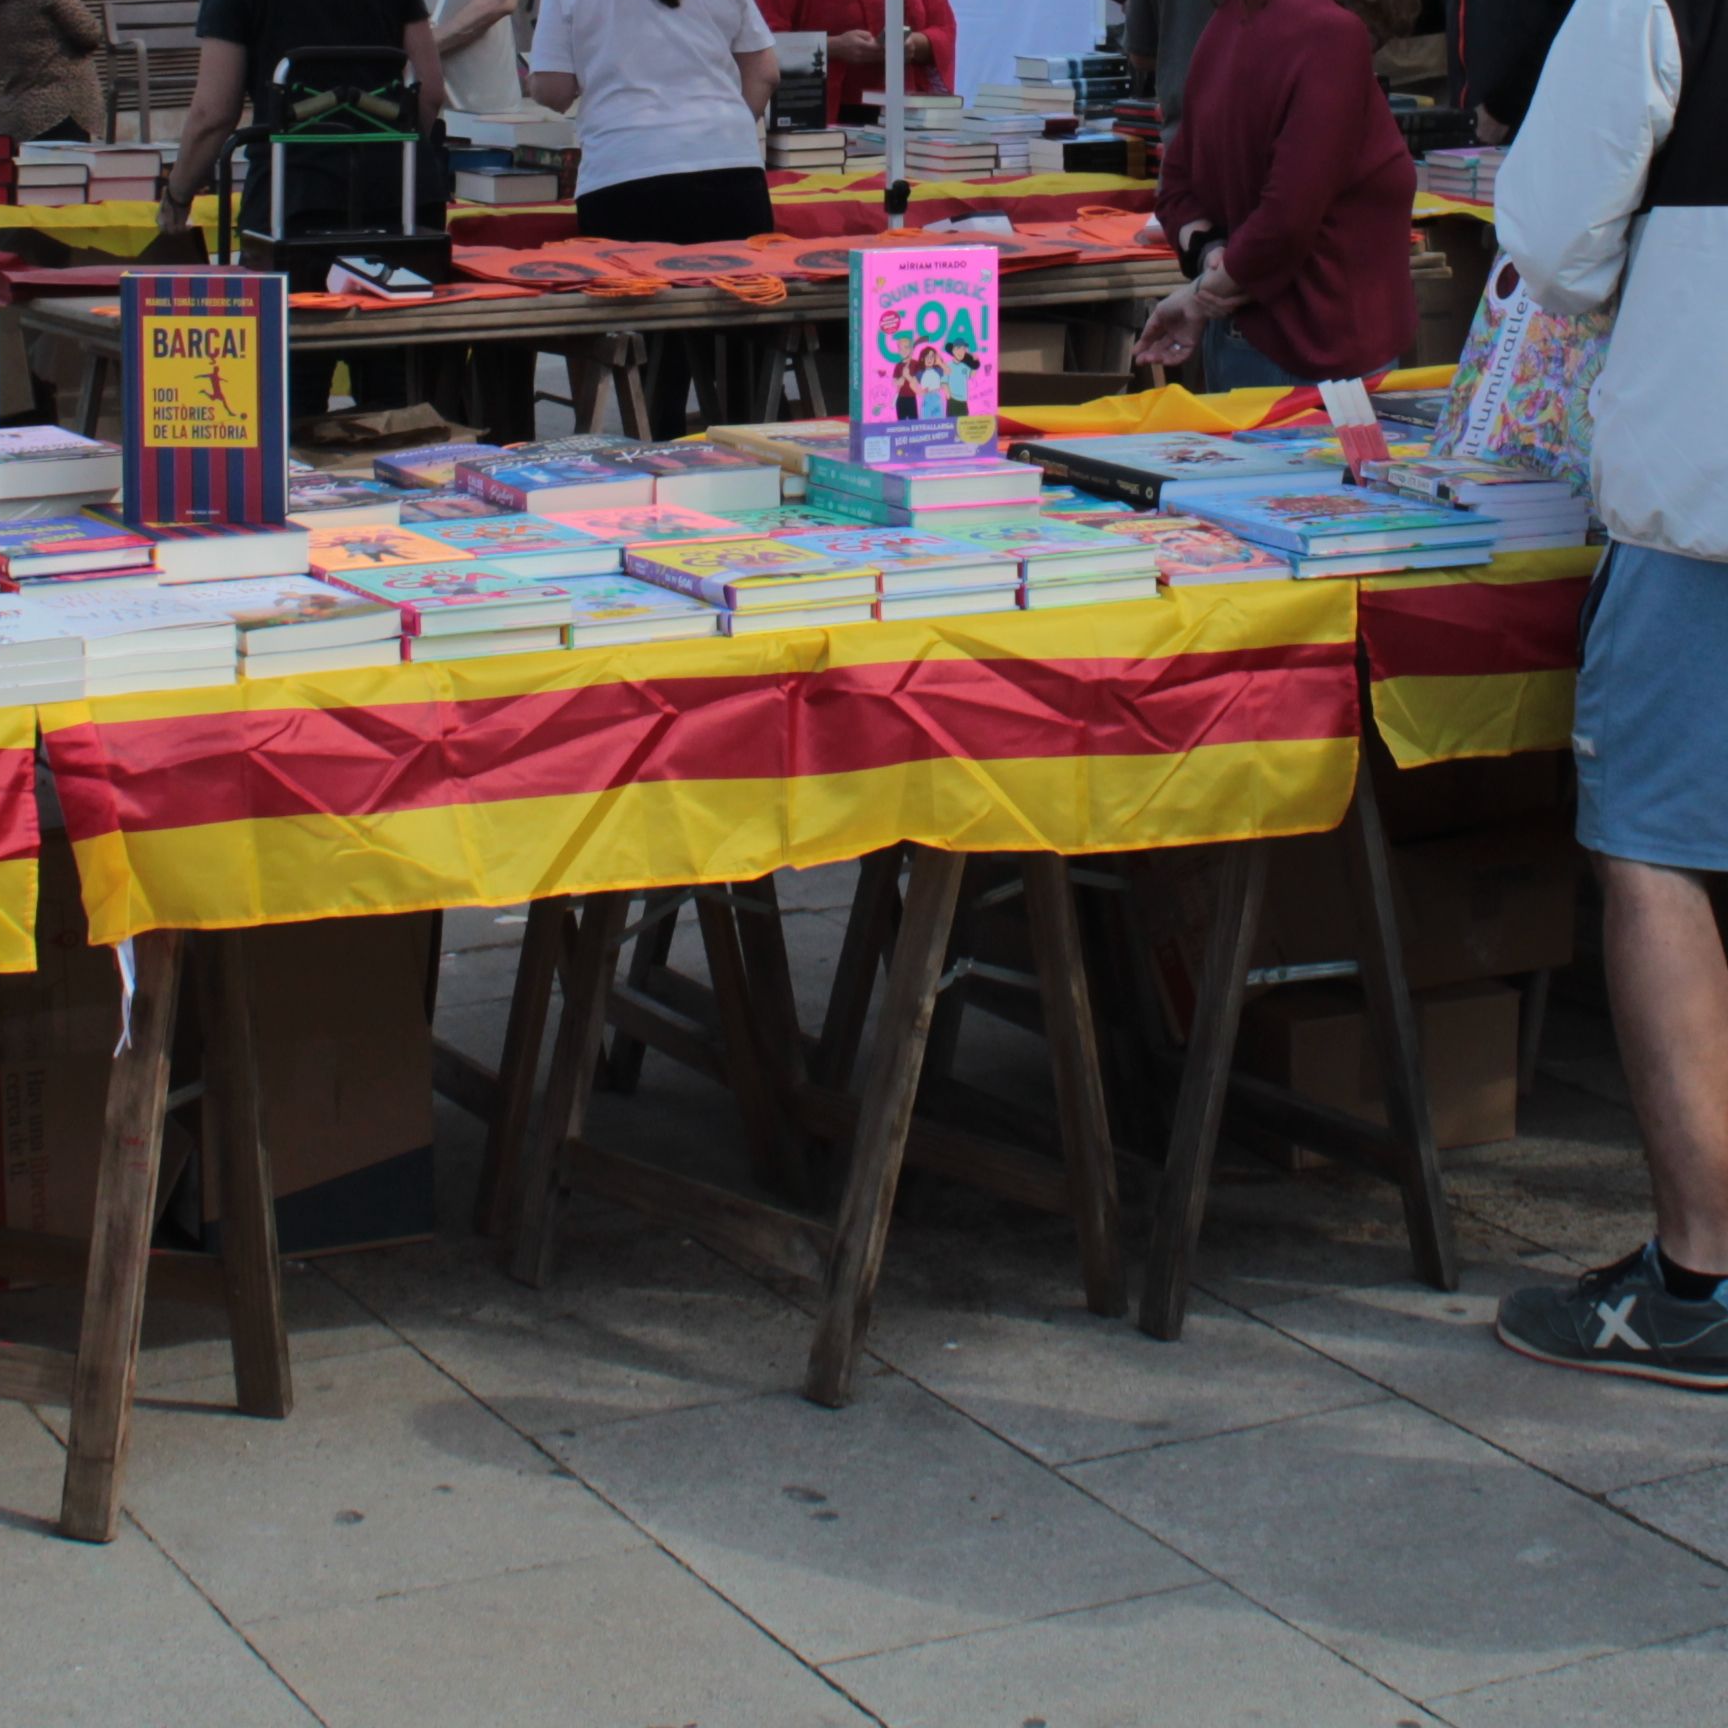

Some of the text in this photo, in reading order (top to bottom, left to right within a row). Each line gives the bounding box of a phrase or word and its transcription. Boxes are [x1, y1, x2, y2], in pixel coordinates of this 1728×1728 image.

[935, 260, 967, 269] TIRADO
[879, 281, 920, 308] QUIN
[152, 327, 247, 365] BARÇA!
[152, 387, 179, 403] 1001
[153, 403, 216, 421] HISTÒRIES
[153, 422, 249, 440] DE LA HISTÒRIA
